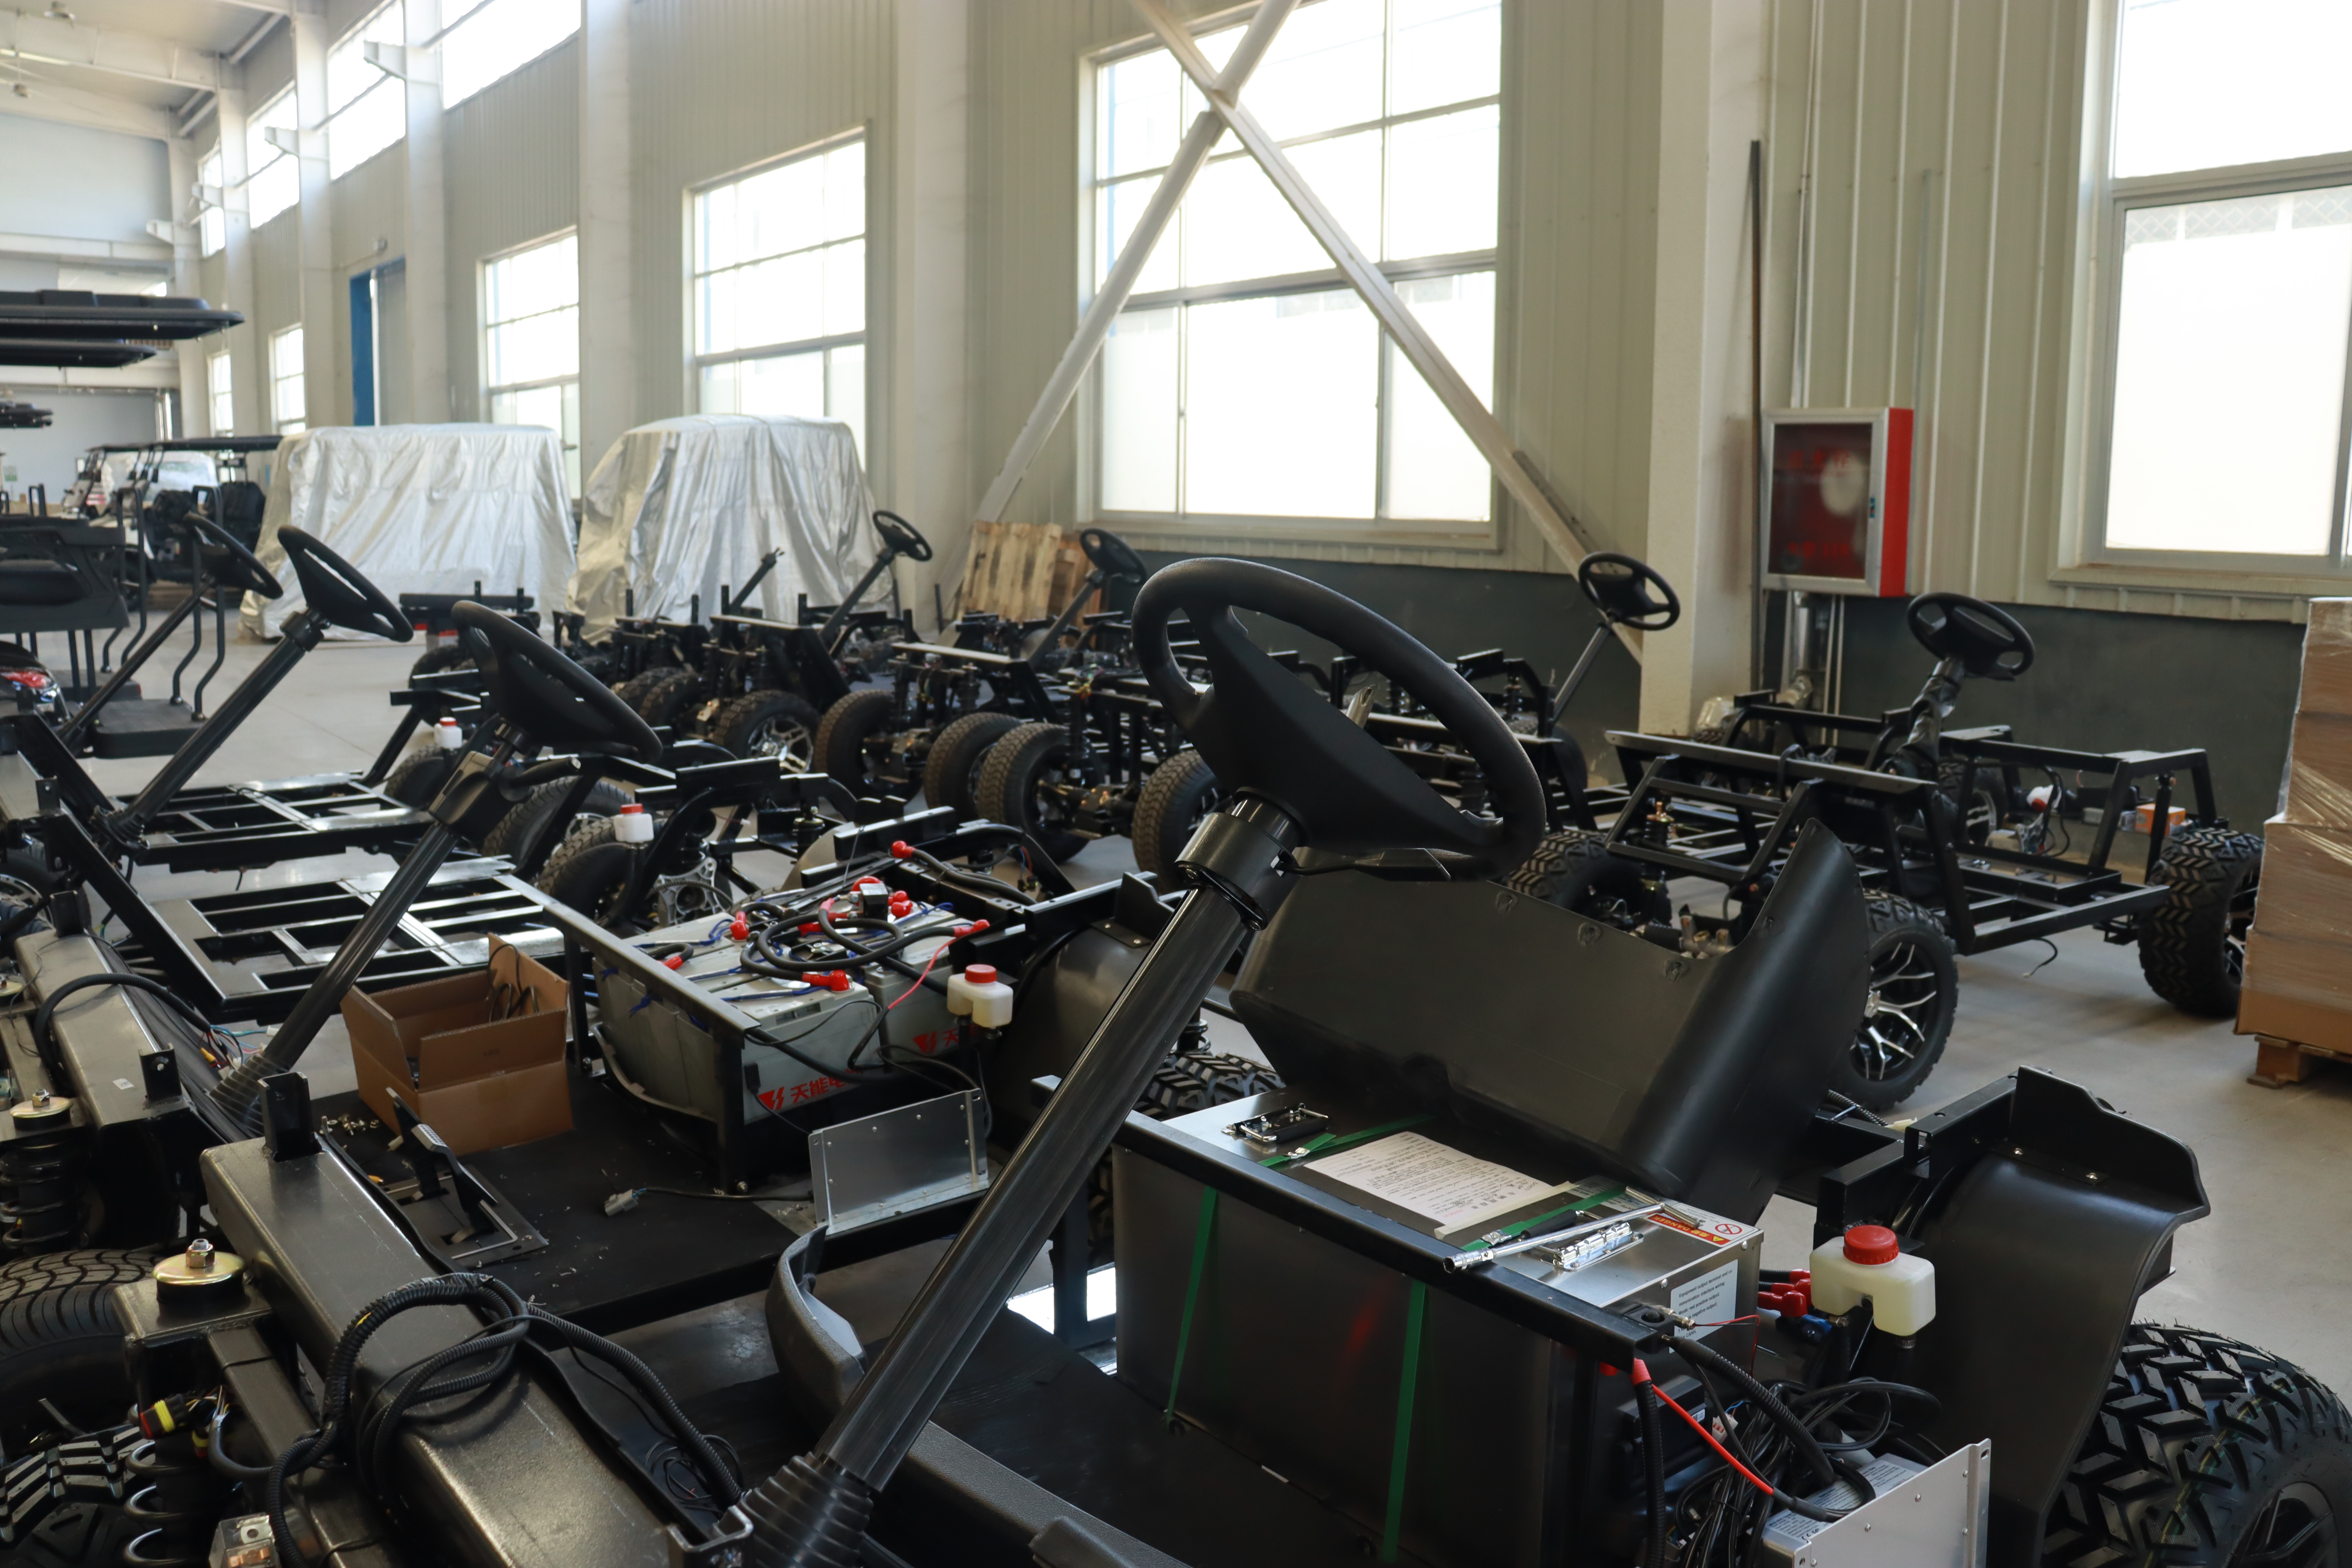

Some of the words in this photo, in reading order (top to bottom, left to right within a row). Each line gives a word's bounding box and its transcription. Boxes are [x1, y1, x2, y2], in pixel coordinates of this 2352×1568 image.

[790, 1069, 863, 1103] 天能电
[1653, 1216, 1690, 1231] DANGER
[1679, 1286, 1697, 1298] Equipment
[1697, 1281, 1708, 1289] output
[1708, 1274, 1721, 1284] terminal
[1700, 1287, 1714, 1296] interface
[1695, 1298, 1708, 1308] positive
[1692, 1308, 1706, 1318] negative
